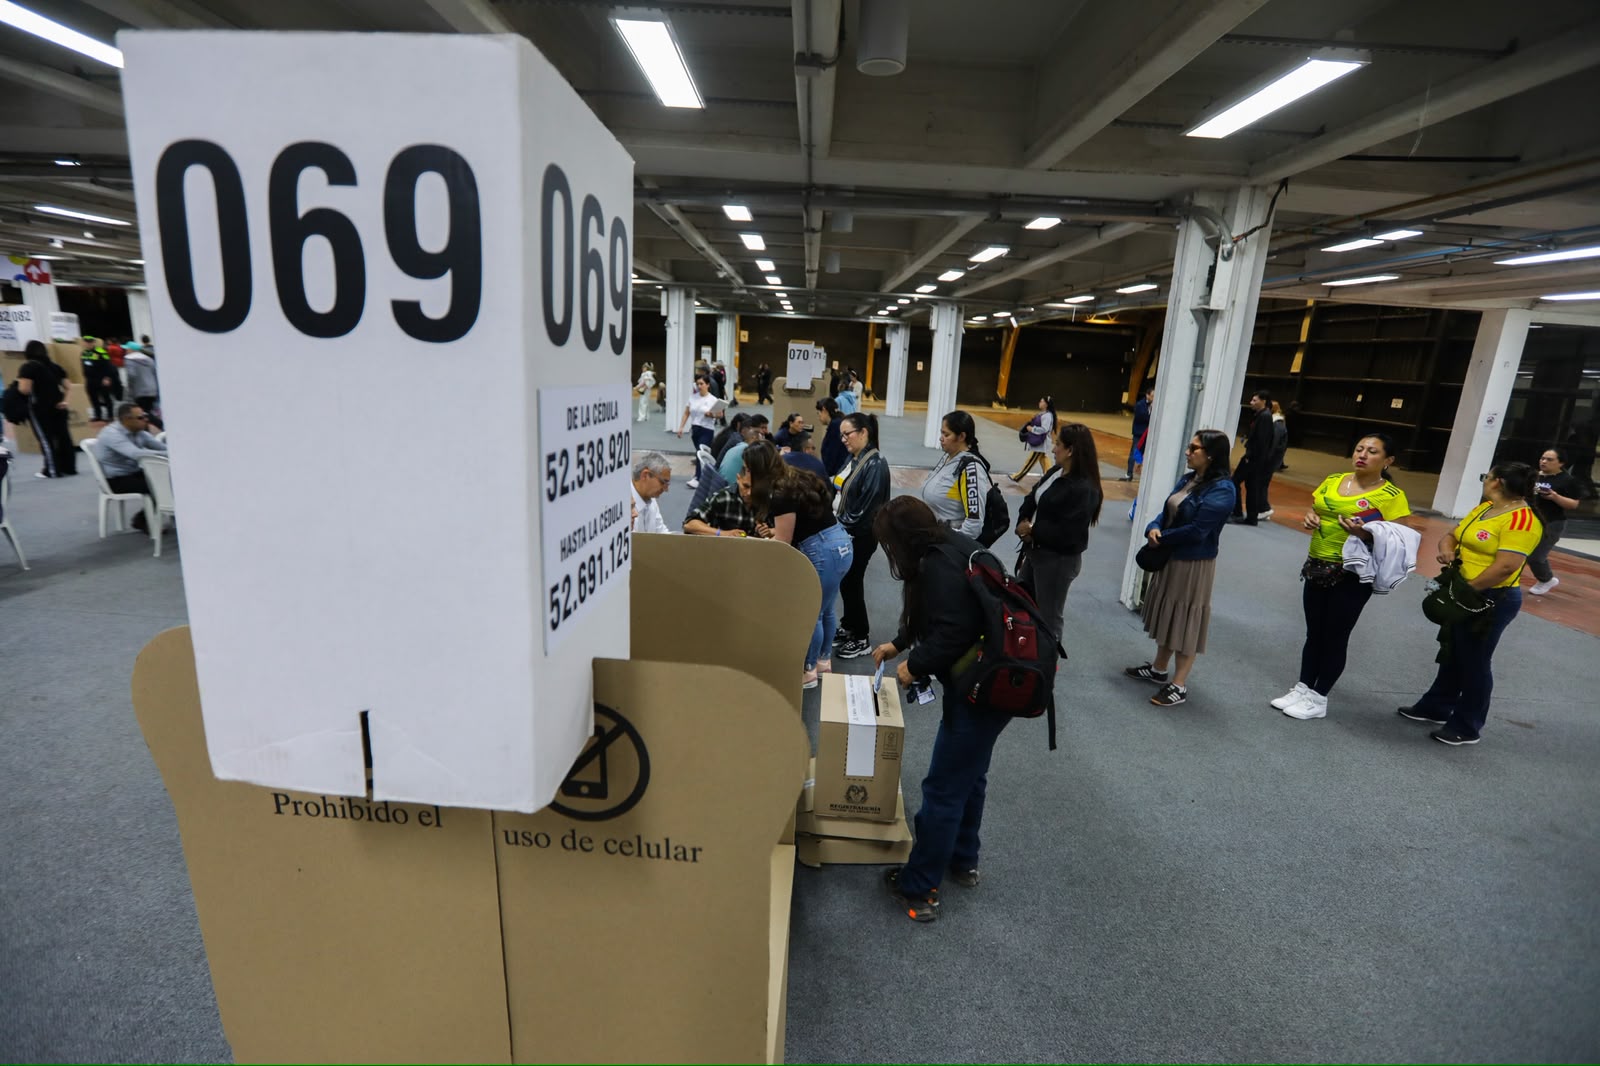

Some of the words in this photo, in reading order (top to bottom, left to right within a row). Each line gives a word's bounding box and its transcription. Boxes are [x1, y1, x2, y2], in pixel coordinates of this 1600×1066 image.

[155, 138, 483, 344] 069
[541, 163, 630, 356] 069
[789, 348, 809, 361] 070
[567, 406, 578, 431] DE
[581, 404, 591, 428] LA
[593, 398, 619, 426] CÉDULA
[546, 429, 630, 503] 52.538.920
[560, 525, 587, 562] HASTA
[588, 519, 598, 544] LA
[600, 501, 623, 534] CÉDULA
[550, 526, 630, 631] 52.691.125
[271, 793, 409, 825] Prohibido
[418, 805, 442, 828] el
[504, 829, 551, 849] uso
[561, 829, 594, 853] de
[604, 834, 703, 864] celular
